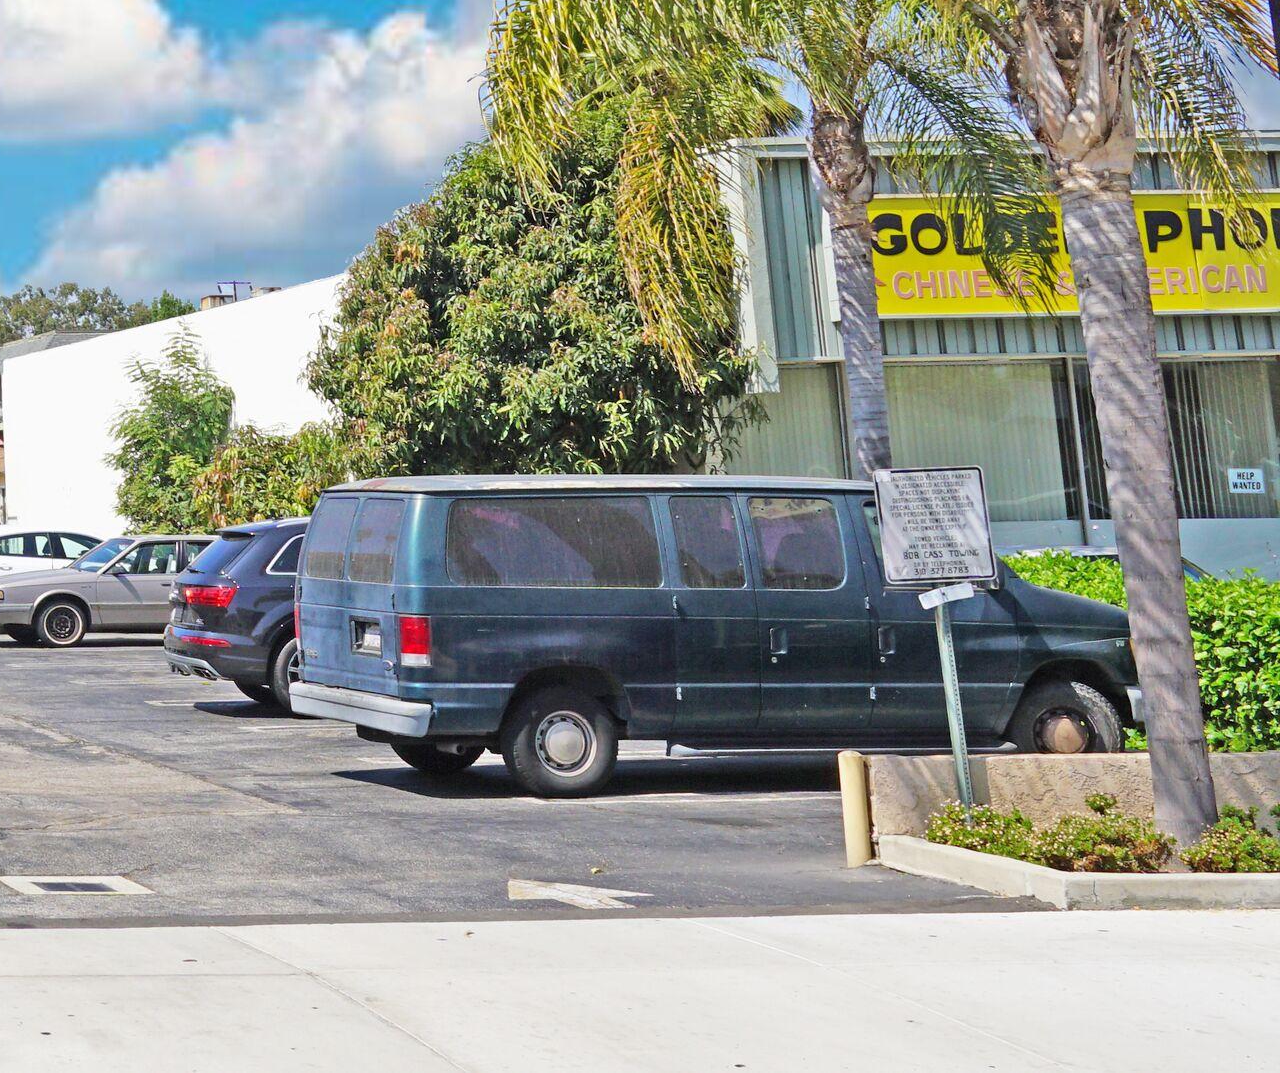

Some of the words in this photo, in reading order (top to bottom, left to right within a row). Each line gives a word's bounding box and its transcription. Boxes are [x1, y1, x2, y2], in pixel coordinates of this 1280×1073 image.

[871, 213, 1069, 256] GOLDE
[1147, 264, 1269, 296] ERICAN
[1236, 471, 1255, 480] HELP
[1232, 481, 1262, 490] WANTED
[949, 548, 980, 558] TOWING
